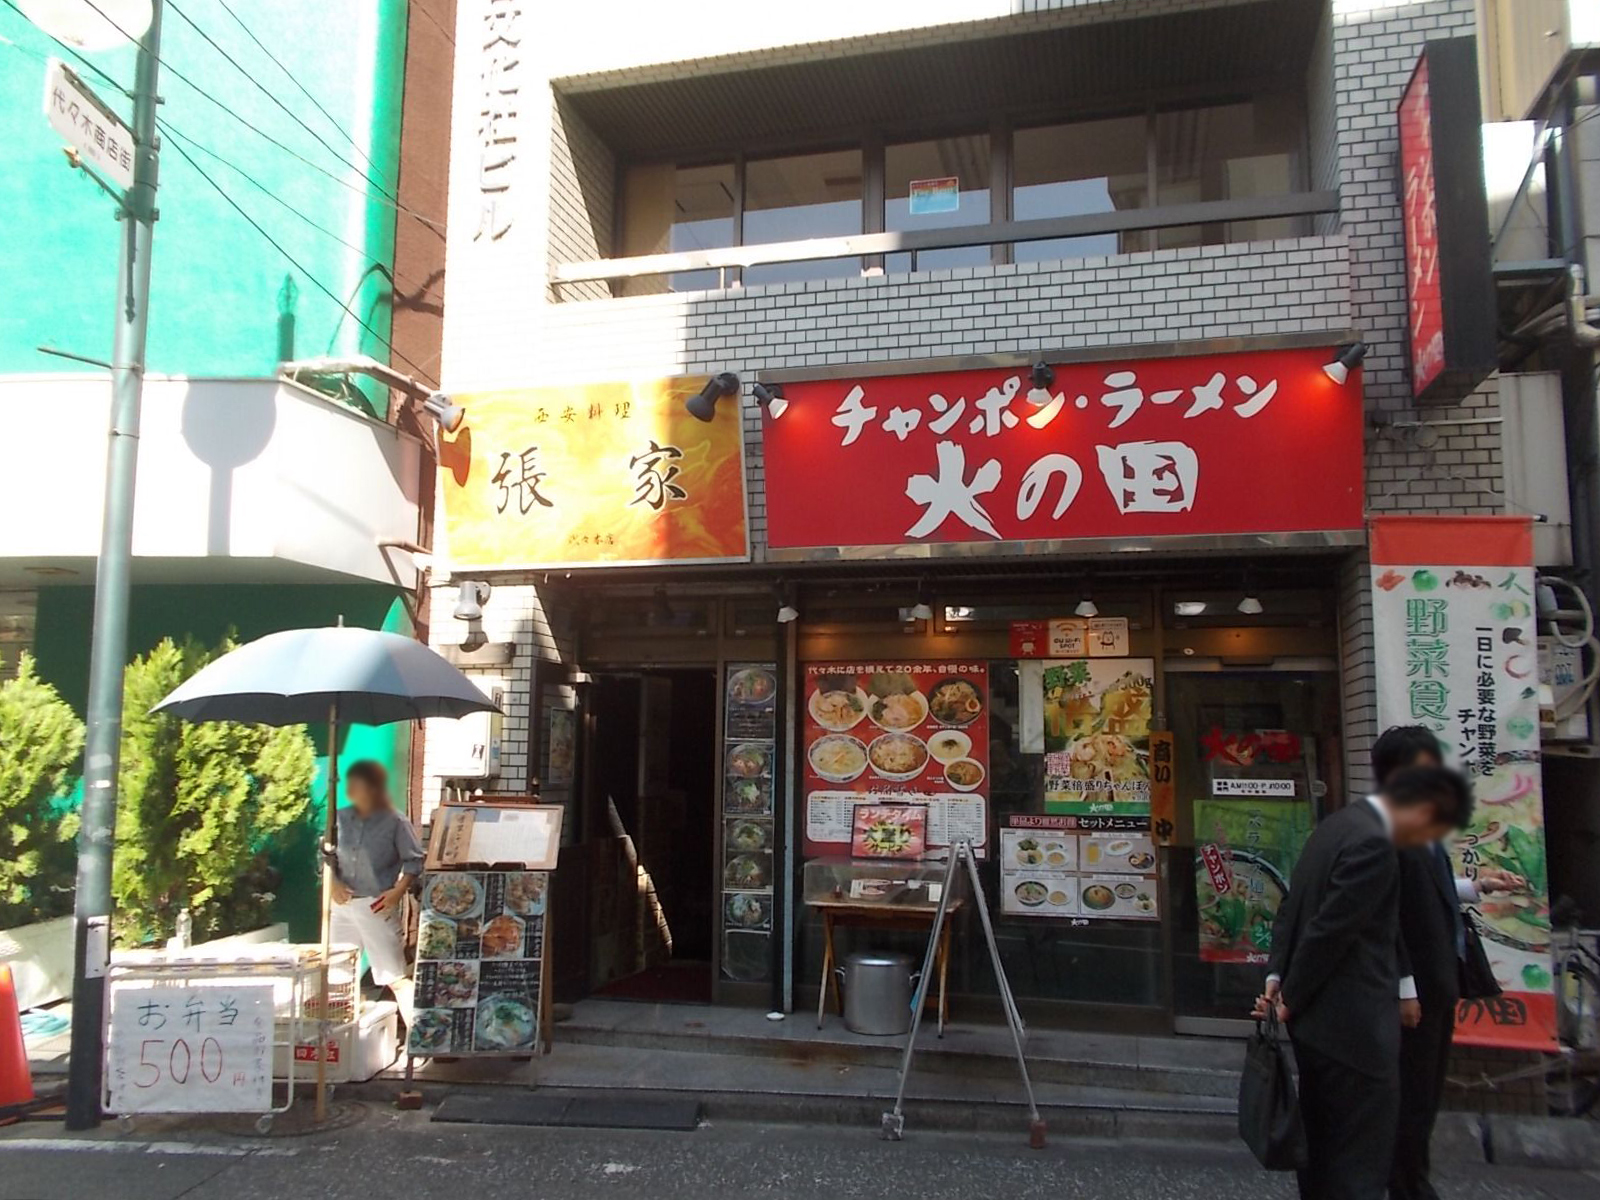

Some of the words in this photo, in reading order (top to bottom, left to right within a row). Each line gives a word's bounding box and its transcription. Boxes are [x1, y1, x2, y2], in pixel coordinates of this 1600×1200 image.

[52, 86, 132, 172] 代々木商店街
[534, 401, 632, 424] 西安料理
[830, 371, 1279, 446] チャンポン・ラーメン
[903, 439, 1199, 541] 火の国
[1475, 625, 1498, 776] 一日に必要な野菜を
[860, 808, 923, 822] ランチタイム
[1078, 816, 1148, 829] セットメニュー
[1202, 844, 1230, 894] チャンポン
[137, 994, 239, 1033] お弁当
[1458, 997, 1527, 1025] の国
